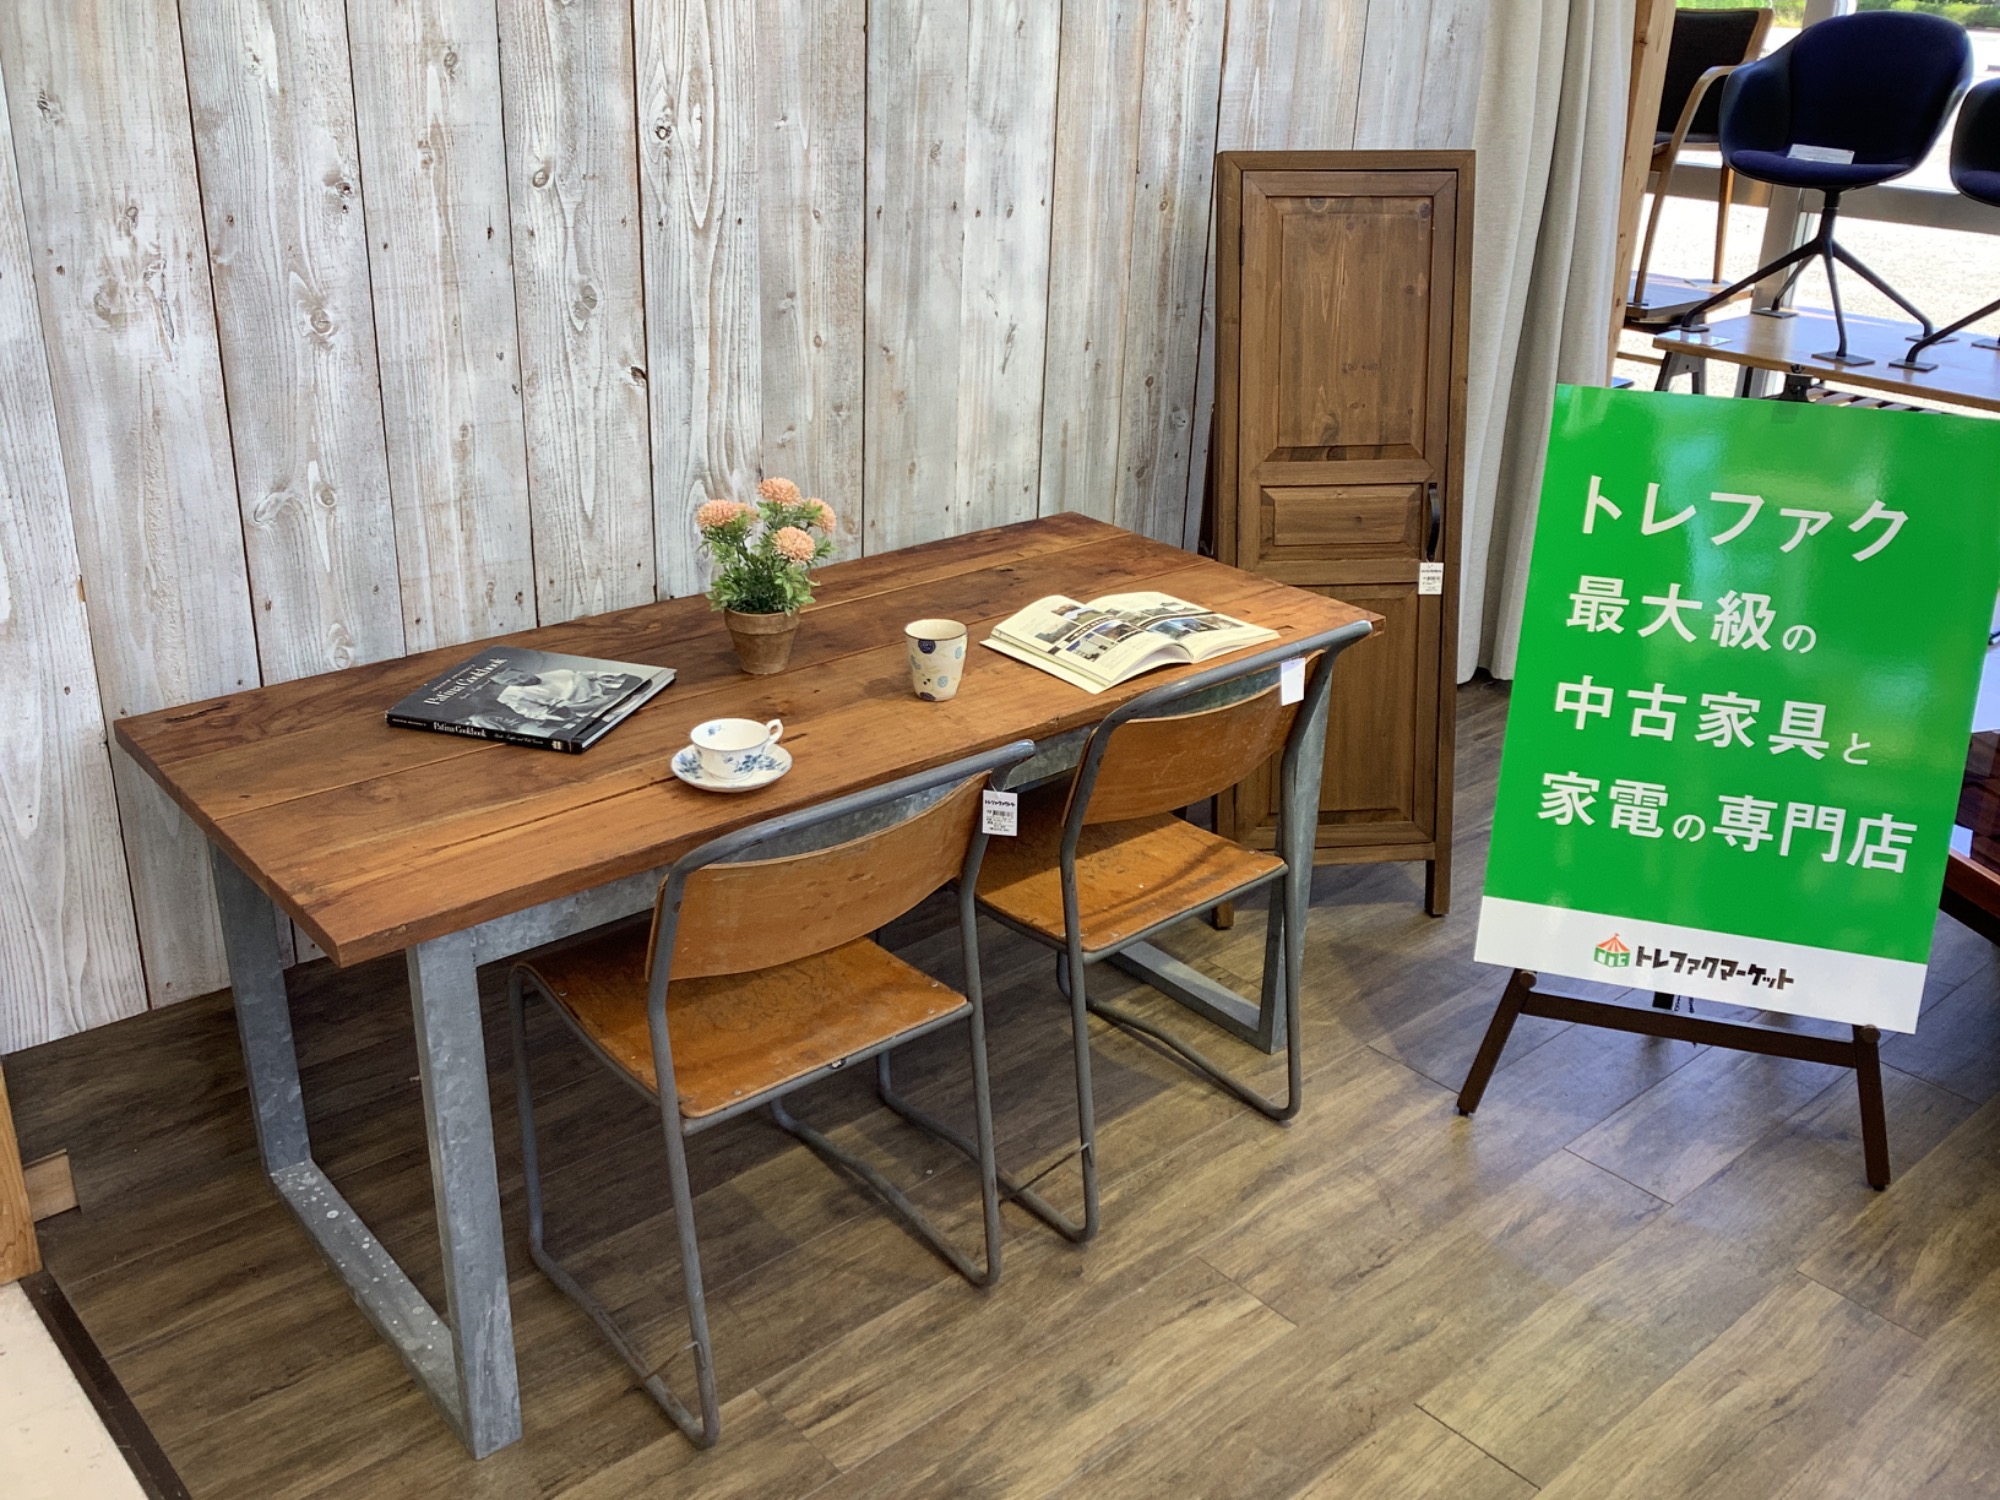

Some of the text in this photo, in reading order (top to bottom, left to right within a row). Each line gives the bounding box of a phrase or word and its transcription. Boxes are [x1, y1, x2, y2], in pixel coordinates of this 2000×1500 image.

[1583, 475, 1909, 562] トレファク
[1566, 575, 1817, 654] 最大級の
[1554, 675, 1871, 766] 中古家具と
[1537, 771, 1917, 874] 家電の専門店
[1635, 945, 1795, 990] トレファクマーケット
